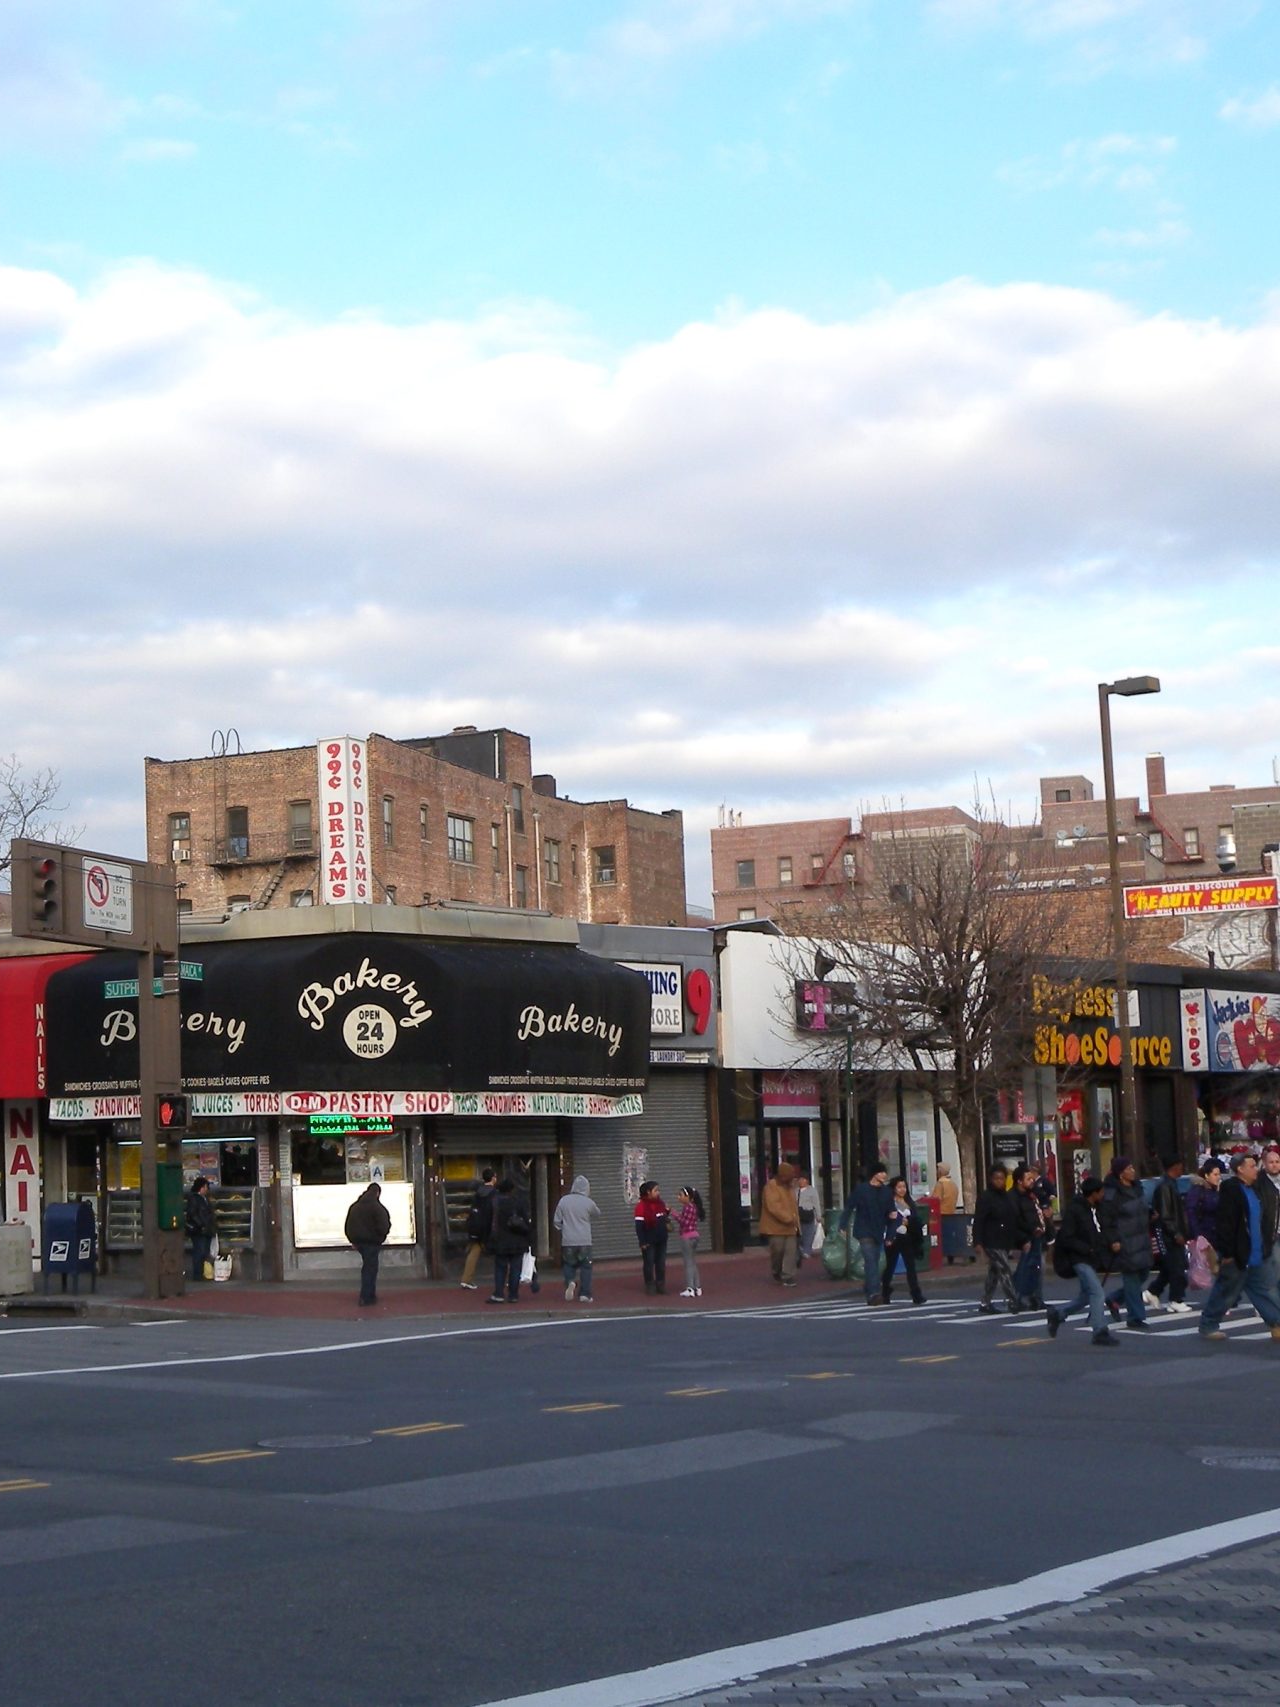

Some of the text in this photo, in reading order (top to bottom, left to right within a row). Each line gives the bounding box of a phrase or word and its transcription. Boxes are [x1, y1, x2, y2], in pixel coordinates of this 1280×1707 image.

[328, 801, 347, 898] DREAMS
[353, 801, 367, 898] DREAMS
[1137, 892, 1204, 911] BEAUTY
[1210, 886, 1274, 906] SUPPLY
[1161, 881, 1241, 894] SUPER DISCOUNT
[181, 964, 198, 978] MAICA
[106, 982, 139, 996] SUTPHI
[298, 957, 433, 1031] Bakery
[1032, 973, 1116, 1024] Pless
[687, 968, 712, 1035] 9
[359, 1010, 380, 1020] OPEN
[100, 1009, 246, 1054] Bery
[356, 1022, 384, 1041] 24
[517, 1003, 623, 1057] Bakery
[35, 1003, 45, 1090] NAILS
[356, 1044, 384, 1054] HOURS
[56, 1096, 141, 1118] TACOS SANDWICH
[202, 1095, 233, 1113] JUICES
[244, 1093, 280, 1112] TORTAS
[329, 1093, 394, 1112] PASTRY
[405, 1093, 451, 1112] SHOP
[532, 1095, 562, 1114] NATURAL
[9, 1107, 35, 1248] NAI
[373, 1166, 382, 1177] A
